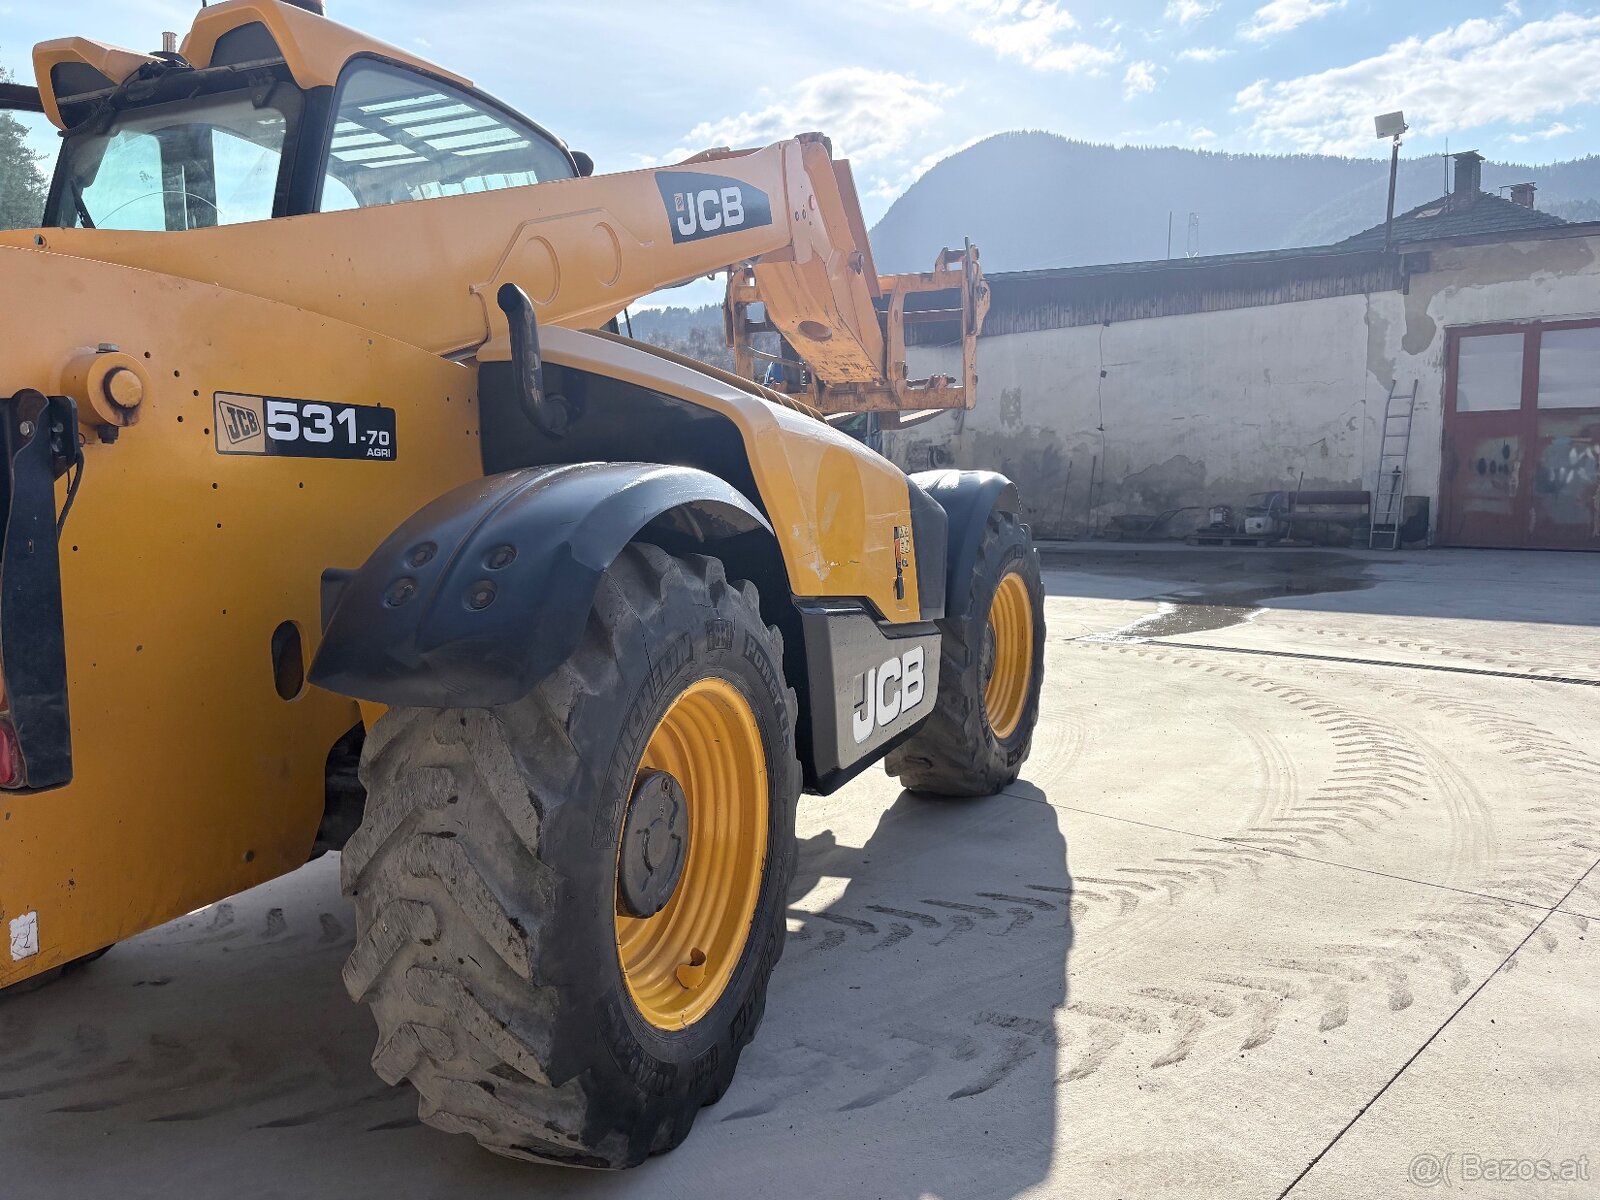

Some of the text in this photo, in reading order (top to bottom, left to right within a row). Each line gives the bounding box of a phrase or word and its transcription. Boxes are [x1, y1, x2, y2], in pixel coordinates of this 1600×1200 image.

[677, 186, 744, 236] JCB
[226, 406, 258, 440] JCB
[366, 447, 391, 458] AGRI
[853, 646, 925, 743] JCB
